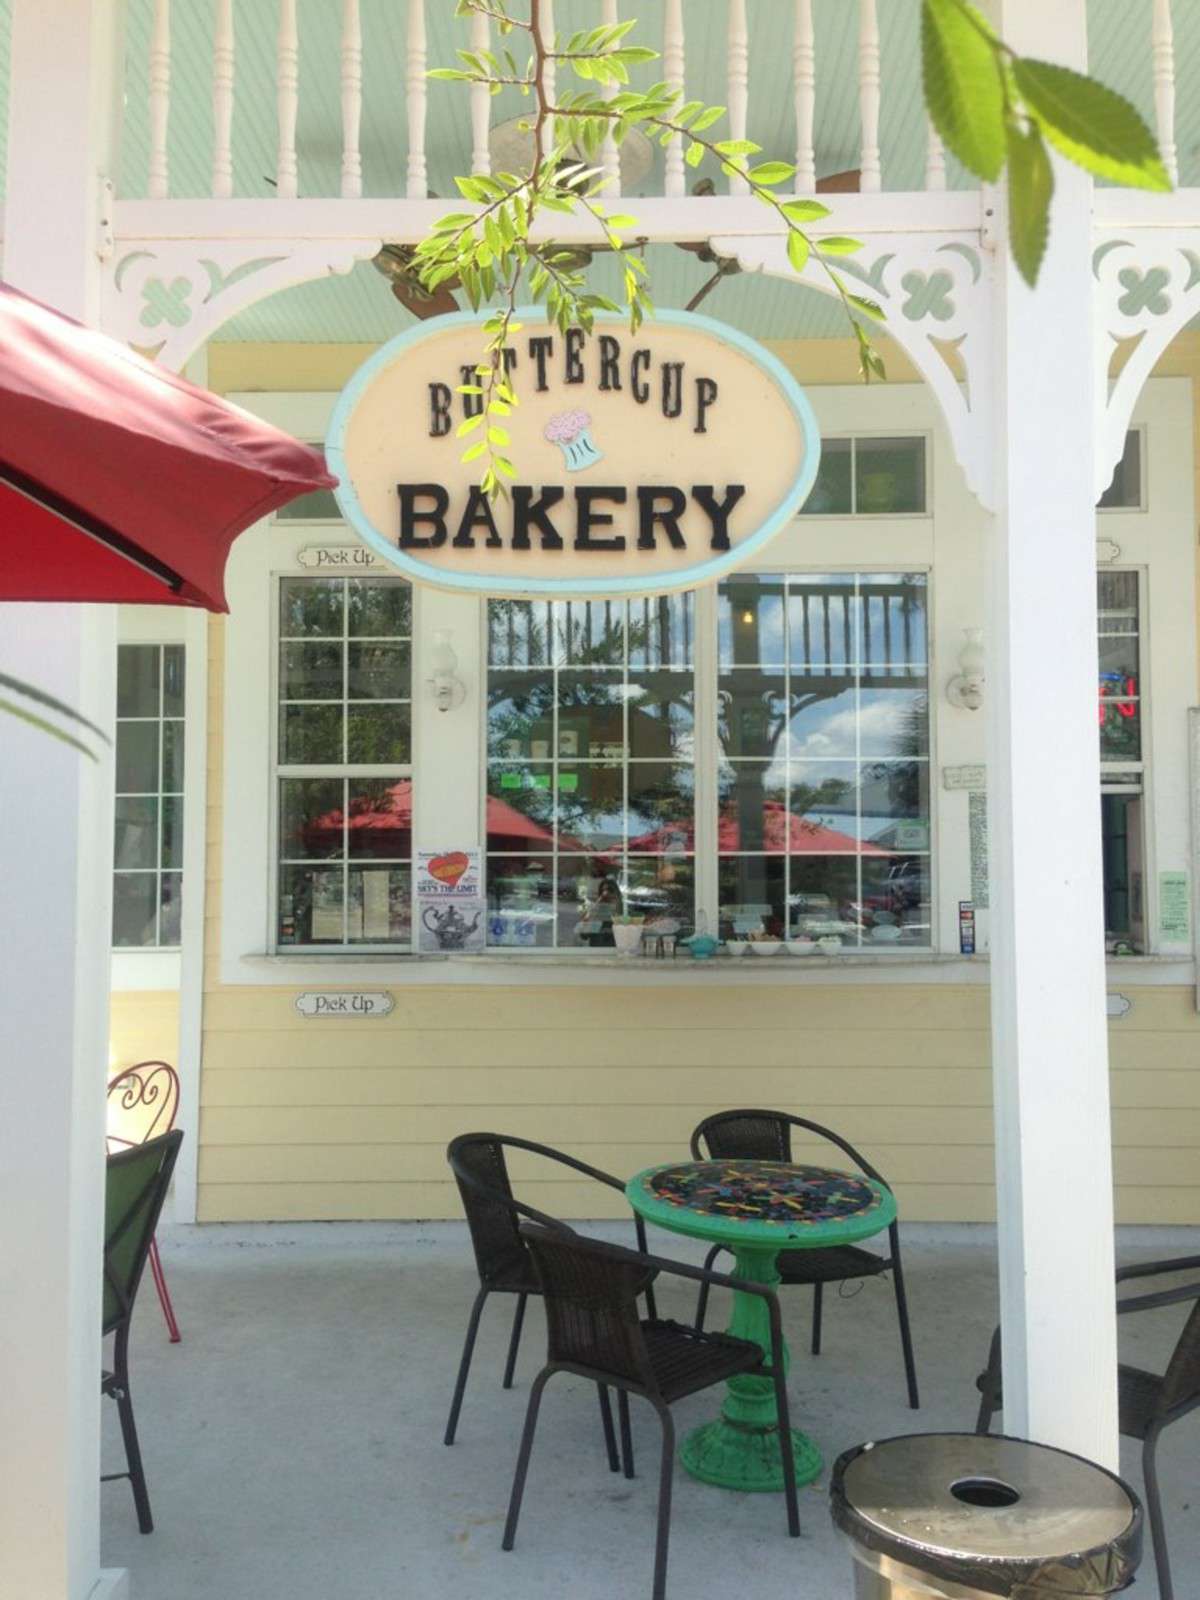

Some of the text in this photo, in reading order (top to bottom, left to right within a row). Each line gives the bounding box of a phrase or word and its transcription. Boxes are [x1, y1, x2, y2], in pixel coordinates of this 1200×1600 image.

[429, 327, 718, 436] BUTTERCUP
[398, 484, 745, 550] BAKERY
[317, 549, 374, 567] Pick Up
[315, 996, 374, 1013] Pick Up
